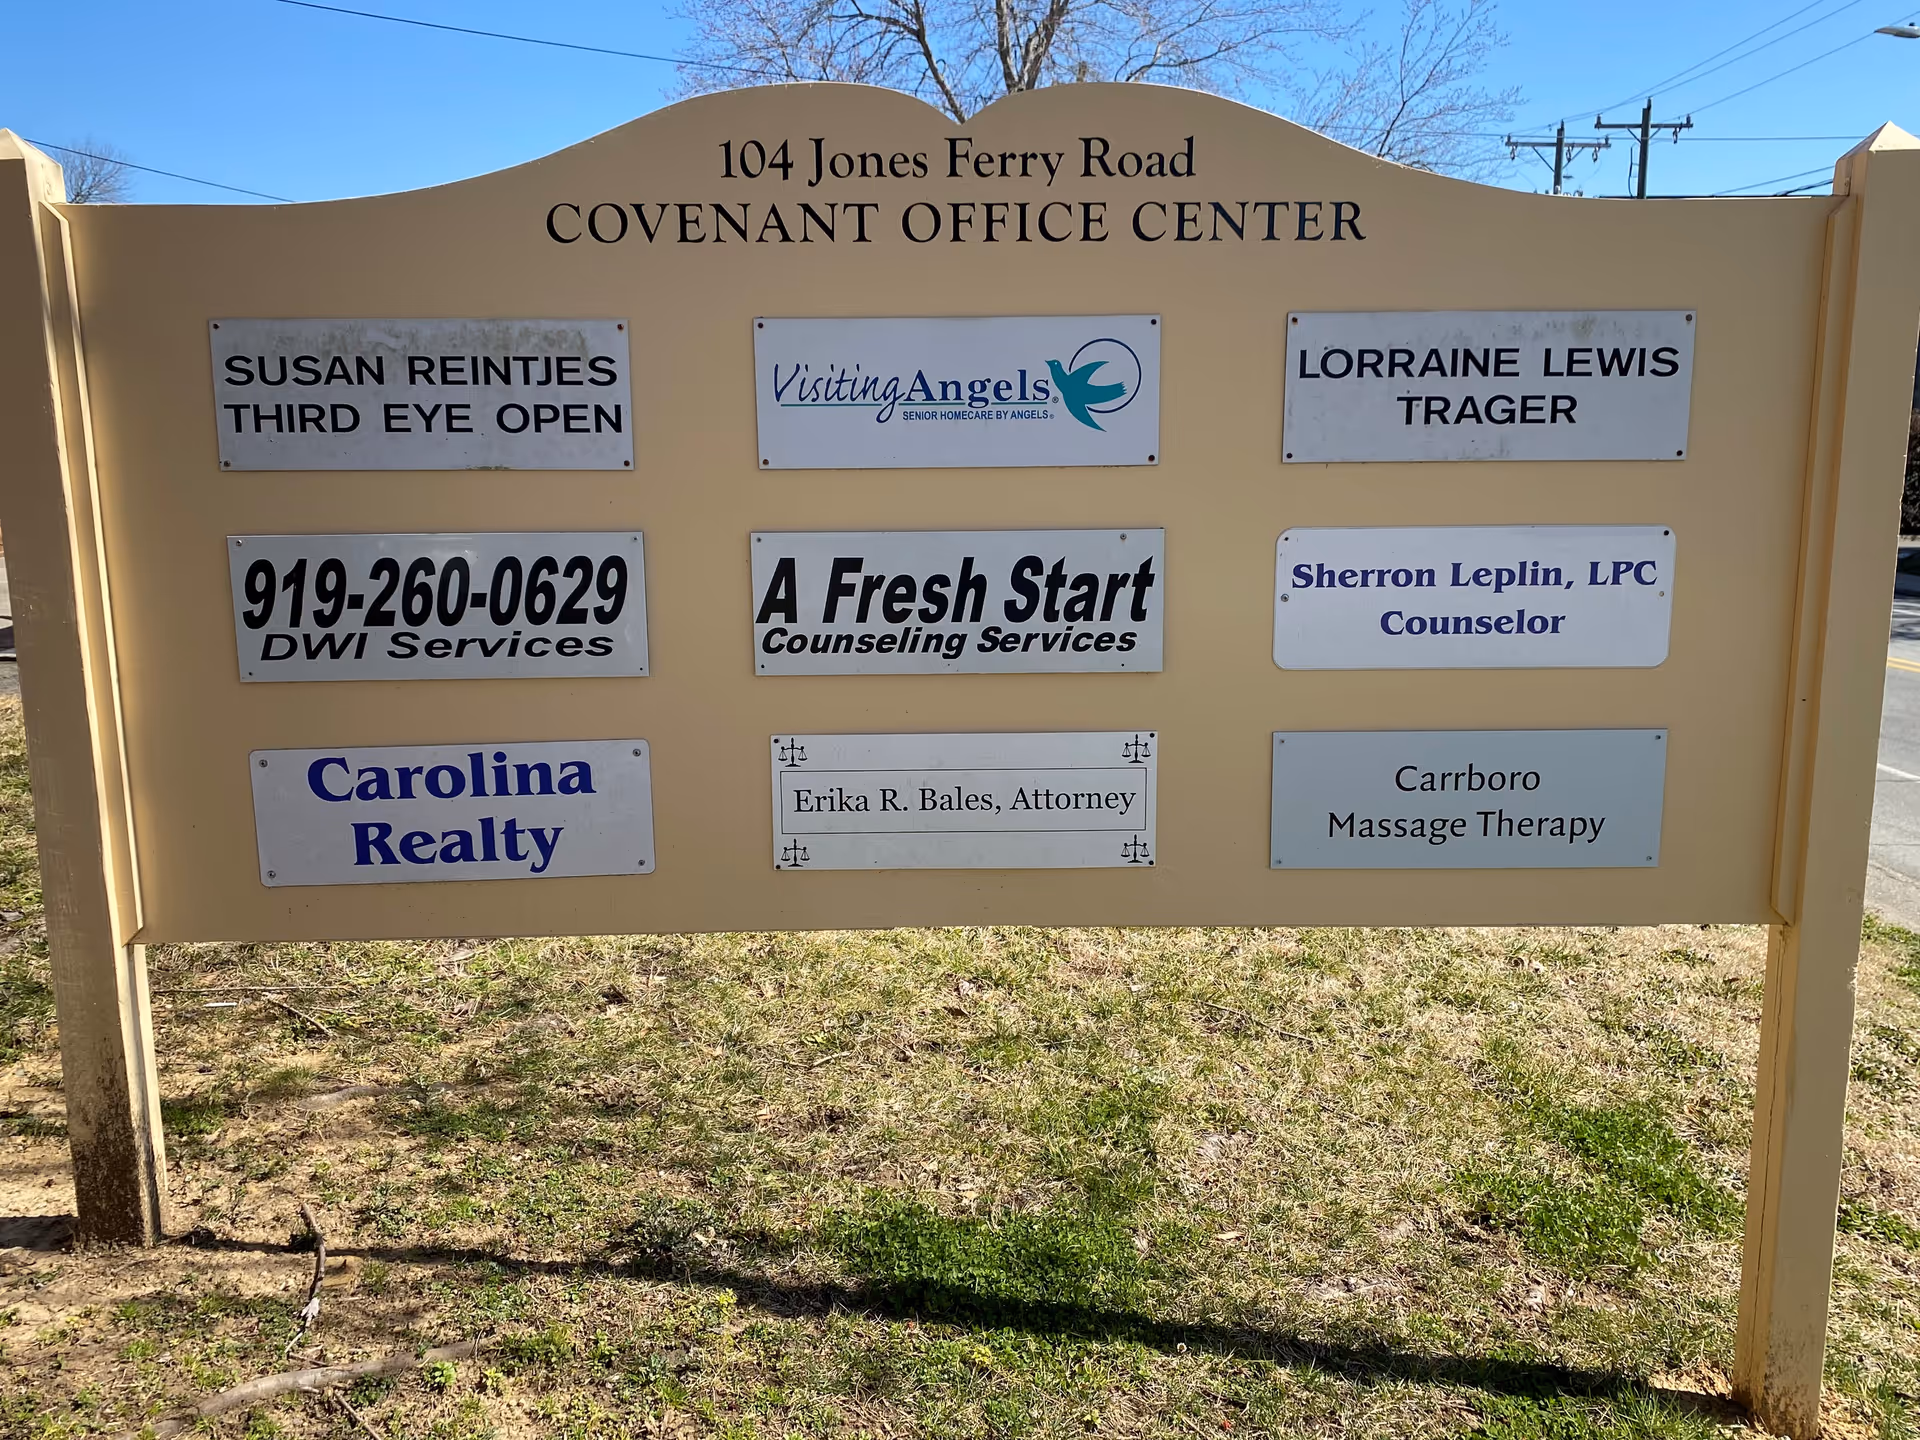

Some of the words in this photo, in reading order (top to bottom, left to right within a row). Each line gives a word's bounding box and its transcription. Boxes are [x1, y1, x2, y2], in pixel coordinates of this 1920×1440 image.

[719, 139, 793, 180] 104
[808, 138, 927, 187] Jones
[945, 138, 1064, 186] Ferry
[1082, 136, 1196, 177] Road
[547, 203, 878, 243] COVENANT
[902, 202, 1108, 242] OFFICE
[1133, 202, 1366, 241] CENTER
[225, 356, 384, 385] SUSAN
[408, 356, 617, 386] REINTJES
[1300, 348, 1519, 378] LORRAINE
[1544, 347, 1679, 377] LEWIS
[224, 404, 360, 433] THIRD
[384, 404, 473, 432] EYE
[497, 404, 622, 433] OPEN
[902, 410, 938, 421] SENIOR
[940, 410, 994, 420] HOMECARE
[995, 410, 1009, 420] BY
[1397, 395, 1577, 425] TRAGER
[243, 556, 627, 629] 919-260-0629
[756, 558, 797, 623] A
[823, 557, 987, 623] Fresh
[1004, 556, 1155, 623] Start
[1292, 563, 1436, 588] Sherron
[1450, 561, 1574, 593] Leplin,
[1588, 561, 1657, 585] LPC
[1381, 609, 1566, 635] Counselor
[261, 632, 368, 661] DWI
[386, 631, 614, 659] Services
[762, 627, 968, 660] Counseling
[976, 626, 1138, 653] Services
[307, 751, 597, 802] Carolina
[1396, 763, 1540, 791] Carrboro
[794, 788, 870, 812] Erika
[880, 789, 907, 811] R.
[919, 786, 1000, 814] Bales,
[1010, 787, 1136, 815] Attorney
[1329, 813, 1466, 845] Massage
[1476, 809, 1606, 844] Therapy
[351, 817, 564, 873] Realty
